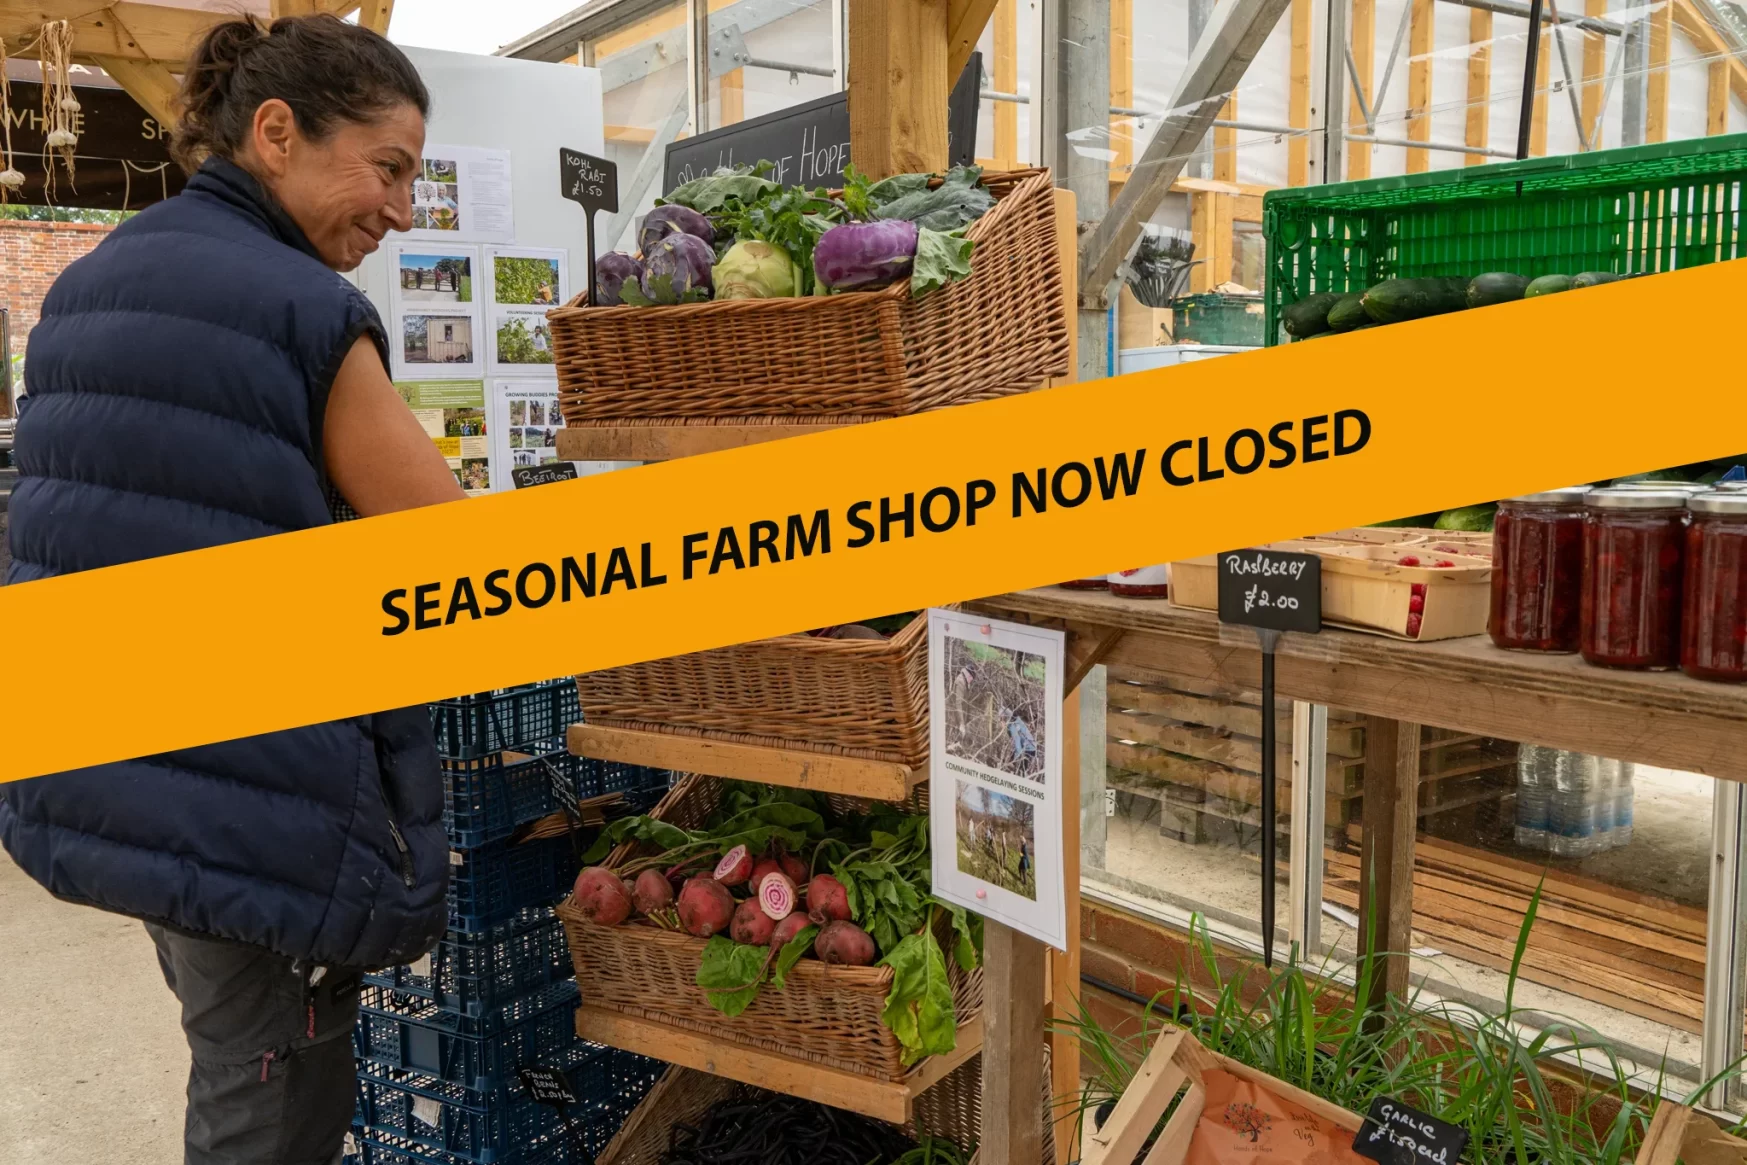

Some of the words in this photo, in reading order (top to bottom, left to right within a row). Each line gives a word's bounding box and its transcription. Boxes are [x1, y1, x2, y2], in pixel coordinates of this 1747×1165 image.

[566, 153, 592, 170] KOHL
[771, 155, 793, 185] OF
[799, 125, 851, 182] HOPE
[571, 180, 603, 197] £1.50
[578, 168, 607, 184] RABI
[1244, 583, 1299, 614] £2.00
[945, 761, 979, 778] COMMUNITY
[979, 773, 1018, 791] HEDGELAYING
[1018, 784, 1045, 801] SESSIONS
[1380, 1104, 1436, 1140] GARLIC
